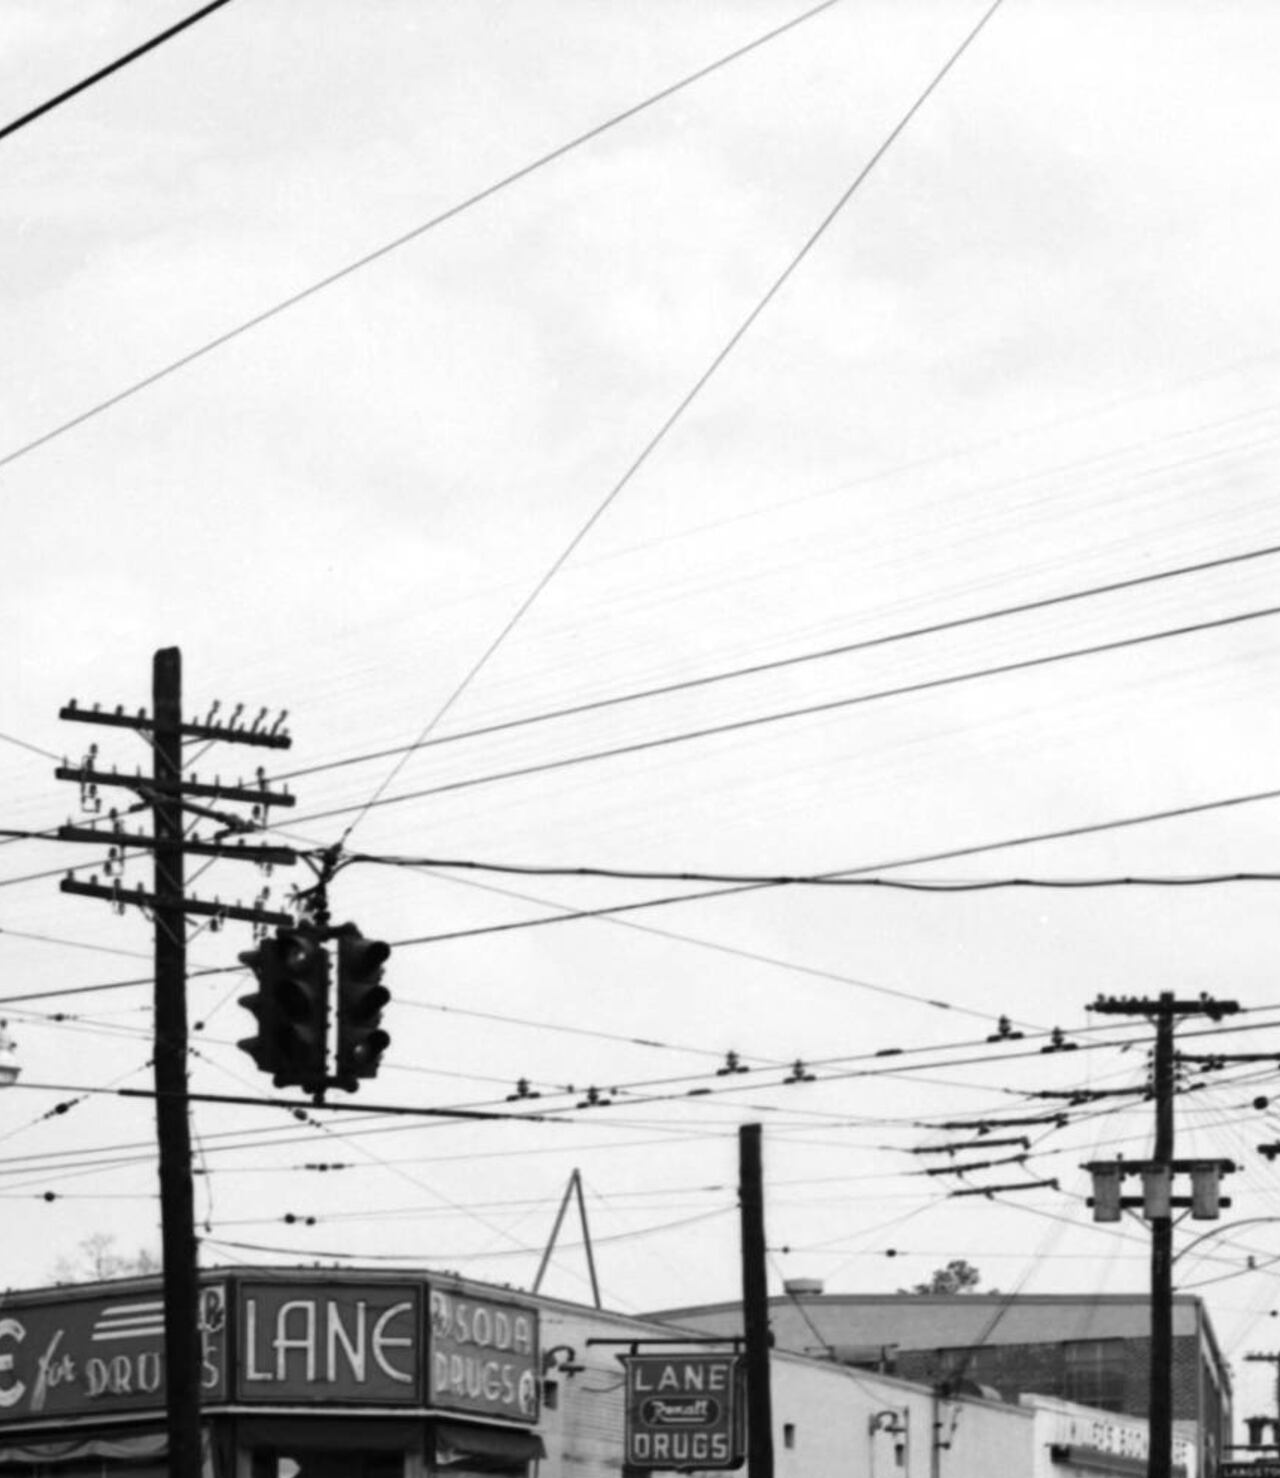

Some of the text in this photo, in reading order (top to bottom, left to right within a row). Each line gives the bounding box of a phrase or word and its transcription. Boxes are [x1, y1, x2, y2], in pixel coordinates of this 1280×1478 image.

[245, 1300, 413, 1384] LANE
[454, 1303, 531, 1355] SODA
[83, 1350, 219, 1397] DRUS
[433, 1351, 516, 1404] DRUGS
[634, 1363, 729, 1392] LANE
[634, 1432, 727, 1460] DRUGS
